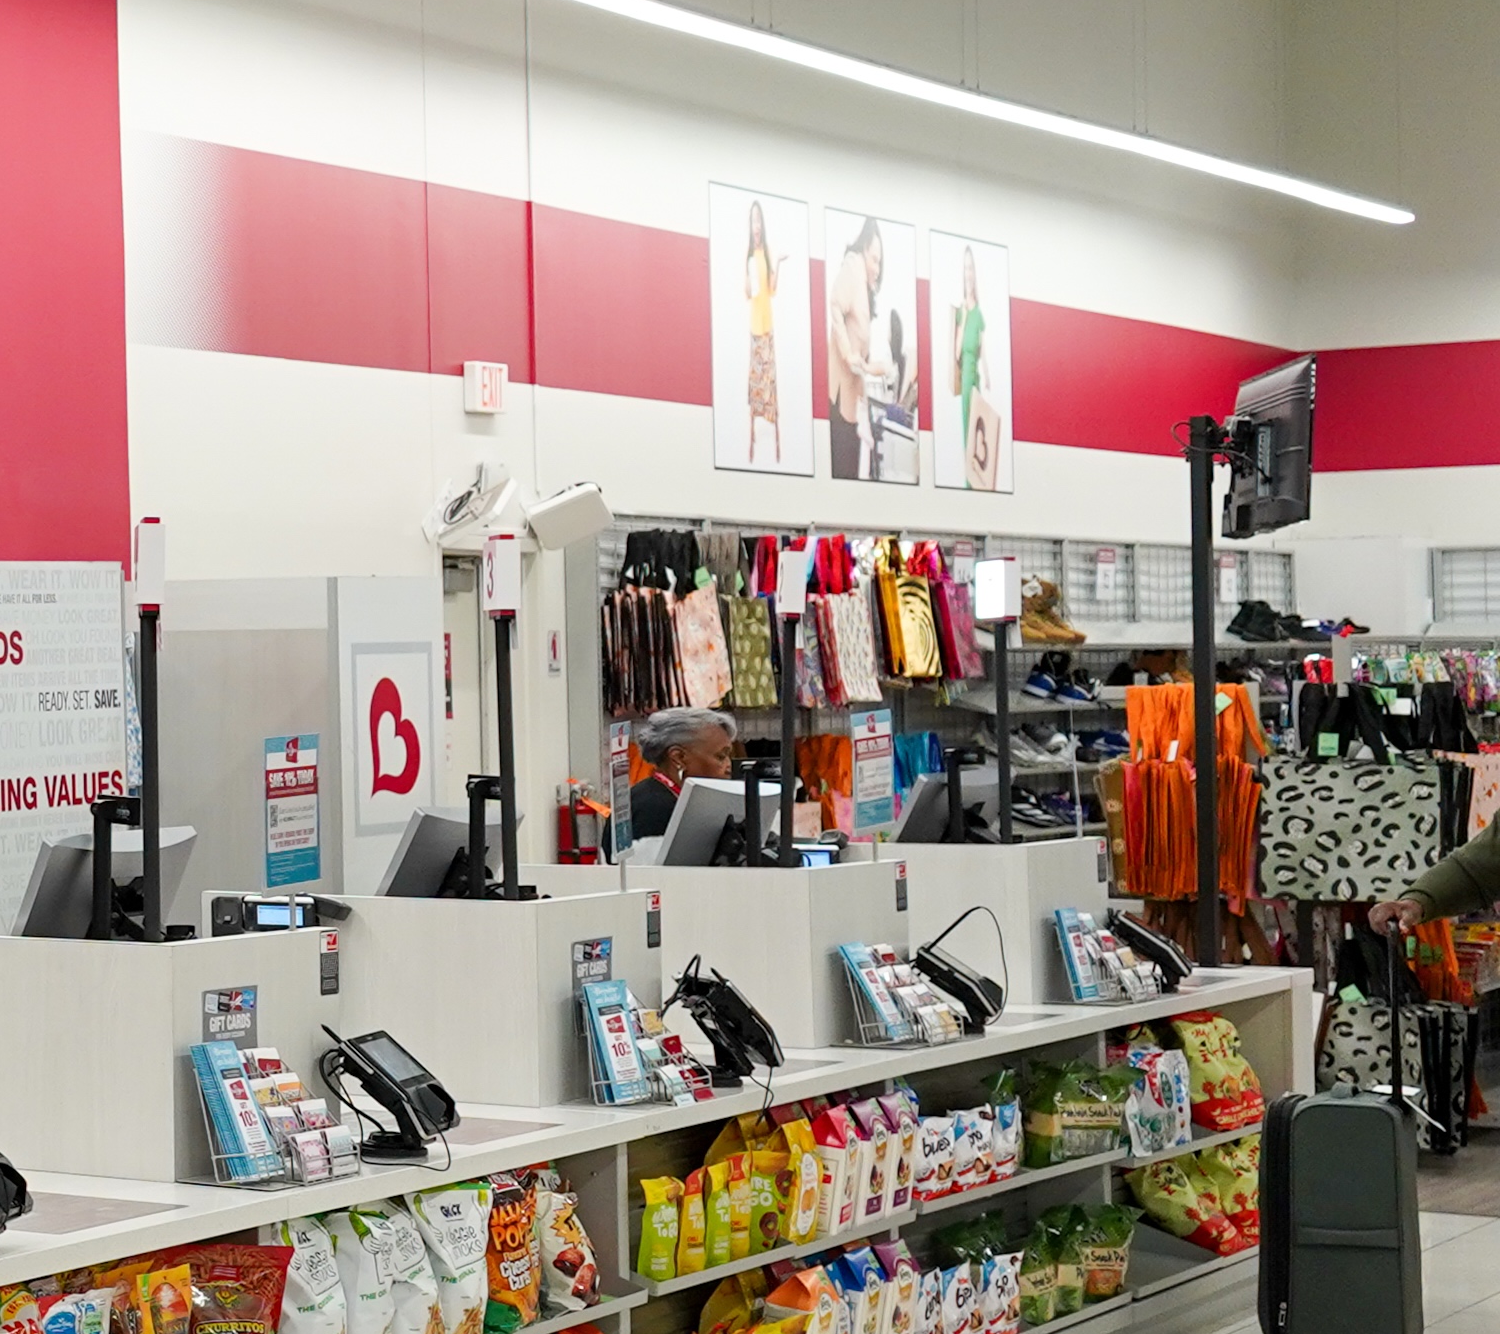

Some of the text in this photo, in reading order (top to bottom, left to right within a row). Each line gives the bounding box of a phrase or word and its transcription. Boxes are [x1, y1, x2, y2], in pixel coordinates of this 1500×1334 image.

[482, 366, 502, 408] EXIT
[487, 552, 494, 599] 3
[38, 690, 120, 712] READY. SET. SAVE.
[44, 770, 123, 807] VALUES
[227, 1013, 251, 1031] CARDS
[195, 1321, 265, 1334] CHURRITOS
